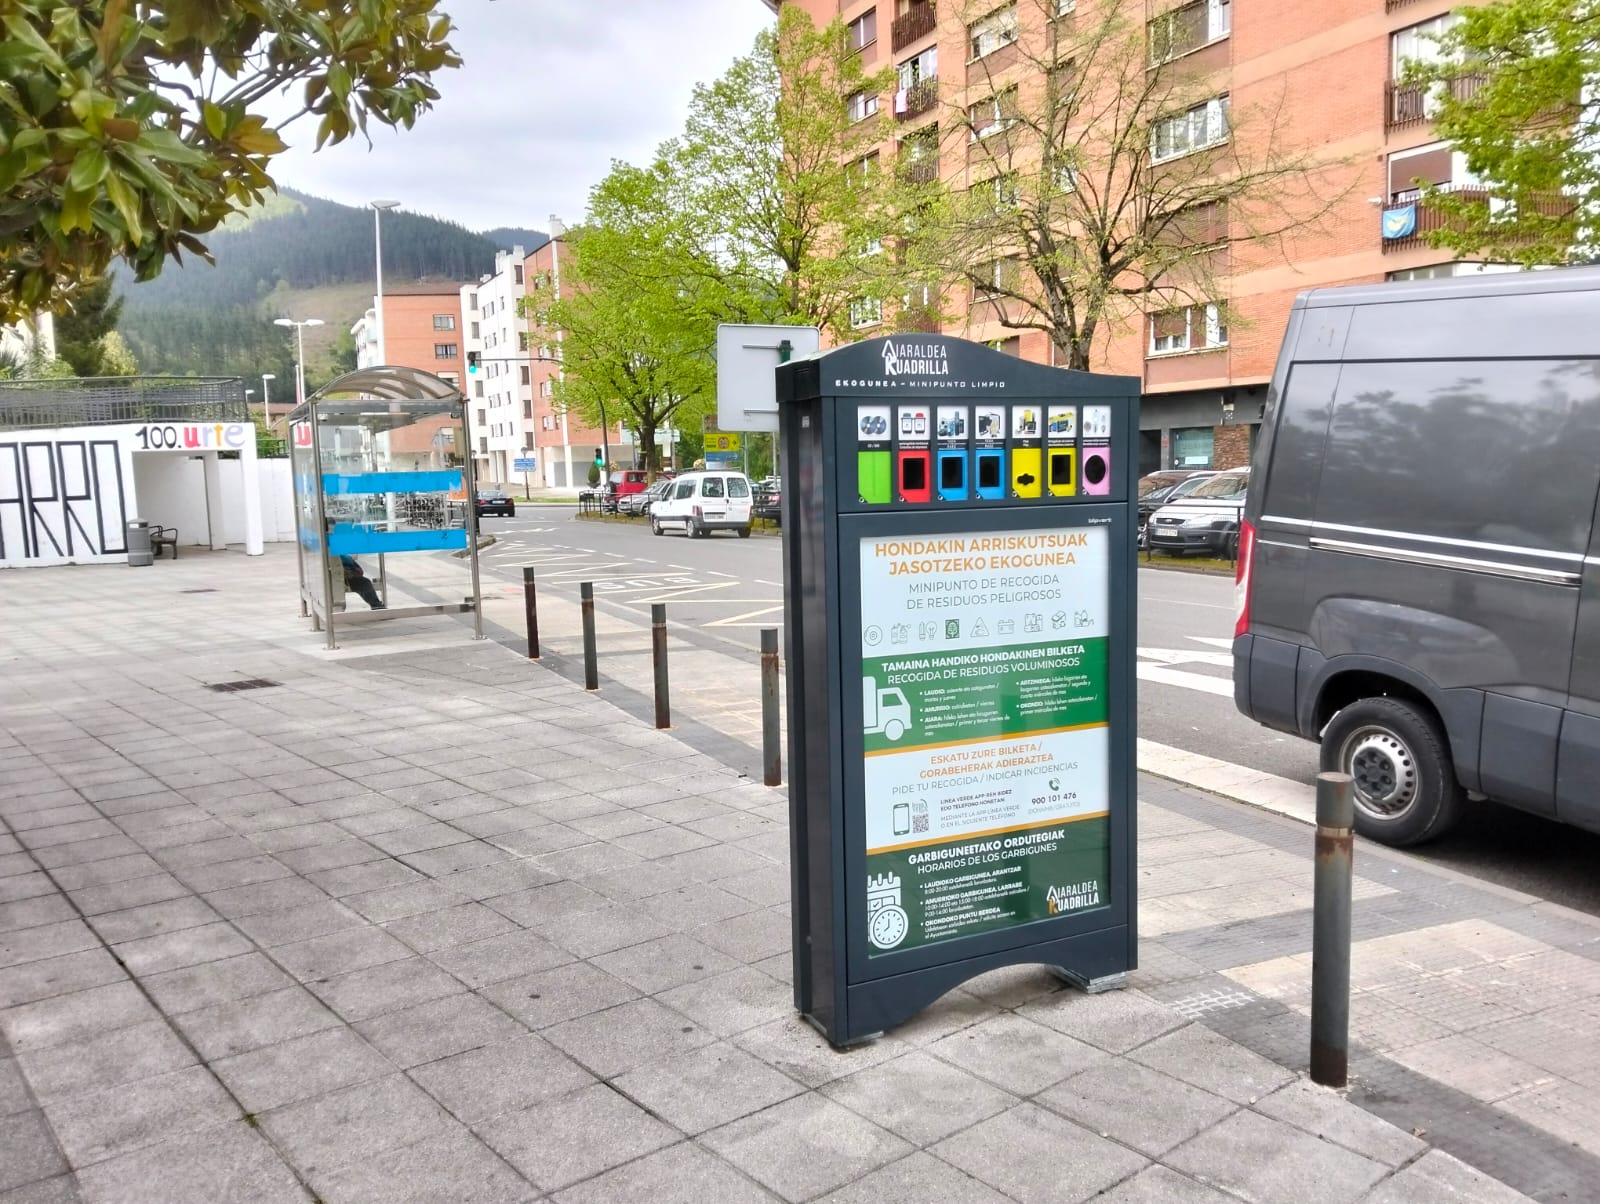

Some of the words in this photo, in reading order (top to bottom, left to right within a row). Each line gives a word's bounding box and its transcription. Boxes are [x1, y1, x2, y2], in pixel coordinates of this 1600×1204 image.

[835, 379, 897, 387] EKOGUNEA
[909, 380, 966, 388] MINIPUNTO
[875, 539, 965, 557] HONDAKIN
[969, 533, 1088, 552] ARRISKUTSUAK
[889, 556, 986, 575] JASOTZEKO
[990, 552, 1076, 569] EKOGUNEA
[909, 579, 978, 594] MINIPUNTO
[981, 577, 997, 589] DE
[1000, 574, 1060, 588] RECOGIDA
[907, 598, 924, 610] DE
[927, 594, 987, 608] RESIDUOS
[990, 589, 1062, 604] PELIGROSOS
[881, 659, 930, 672] TAMAINA
[931, 654, 979, 668] HANDIKO
[980, 648, 1046, 663] HONDAKINEN
[1046, 645, 1085, 657] BILKETA
[887, 671, 942, 685] RECOGIDA
[943, 669, 958, 679] DE
[960, 664, 1009, 678] RESIDUOS
[1010, 657, 1081, 673] VOLUMINOSOS
[919, 762, 993, 779] GORABEHERAK
[995, 753, 1054, 769] ADIERAZTEA
[930, 751, 969, 765] ESKATU
[971, 748, 996, 760] ZURE
[998, 743, 1037, 756] BILKETA
[892, 784, 915, 795] PIDE
[917, 782, 929, 791] TU
[931, 775, 979, 789] RECOGIDA
[985, 769, 1022, 782] INDICAR
[1024, 761, 1079, 776] INCIDENCIAS
[1031, 796, 1046, 805] 900
[1048, 794, 1061, 803] 101
[1063, 791, 1077, 800] 476
[908, 840, 1002, 865] GARBIGUNEETAKO
[1003, 829, 1065, 848] ORDUTEGIAK
[917, 857, 966, 875] HORARIOS
[967, 855, 981, 866] DE
[982, 852, 1000, 863] LOS
[1001, 842, 1058, 859] GARBIGUNES
